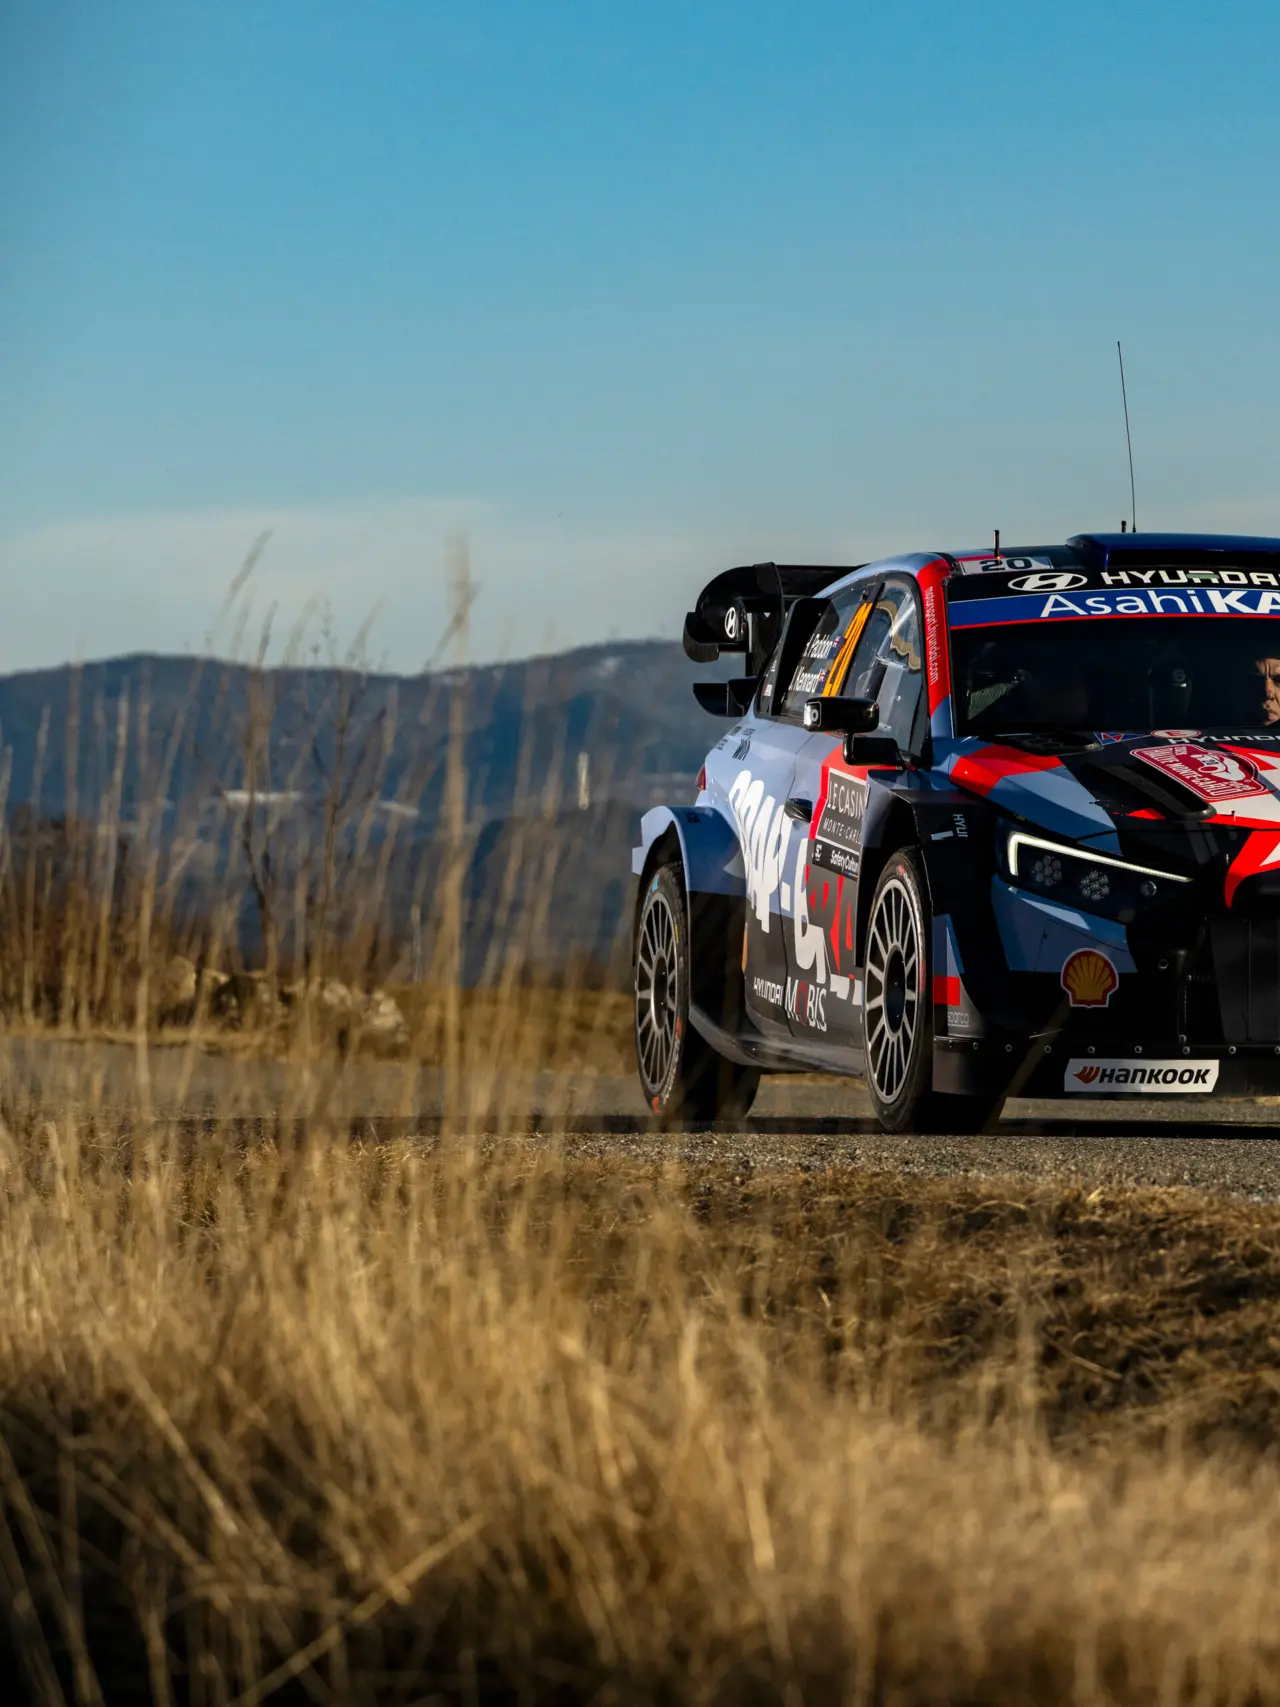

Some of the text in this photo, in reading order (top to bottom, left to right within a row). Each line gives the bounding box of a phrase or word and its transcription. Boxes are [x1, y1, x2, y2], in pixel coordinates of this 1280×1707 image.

[979, 558, 1032, 572] 20
[925, 586, 941, 686] motorsport.hyundai.com
[827, 780, 865, 820] LE CASIN
[753, 976, 828, 1033] HYUNDAI MOBIS
